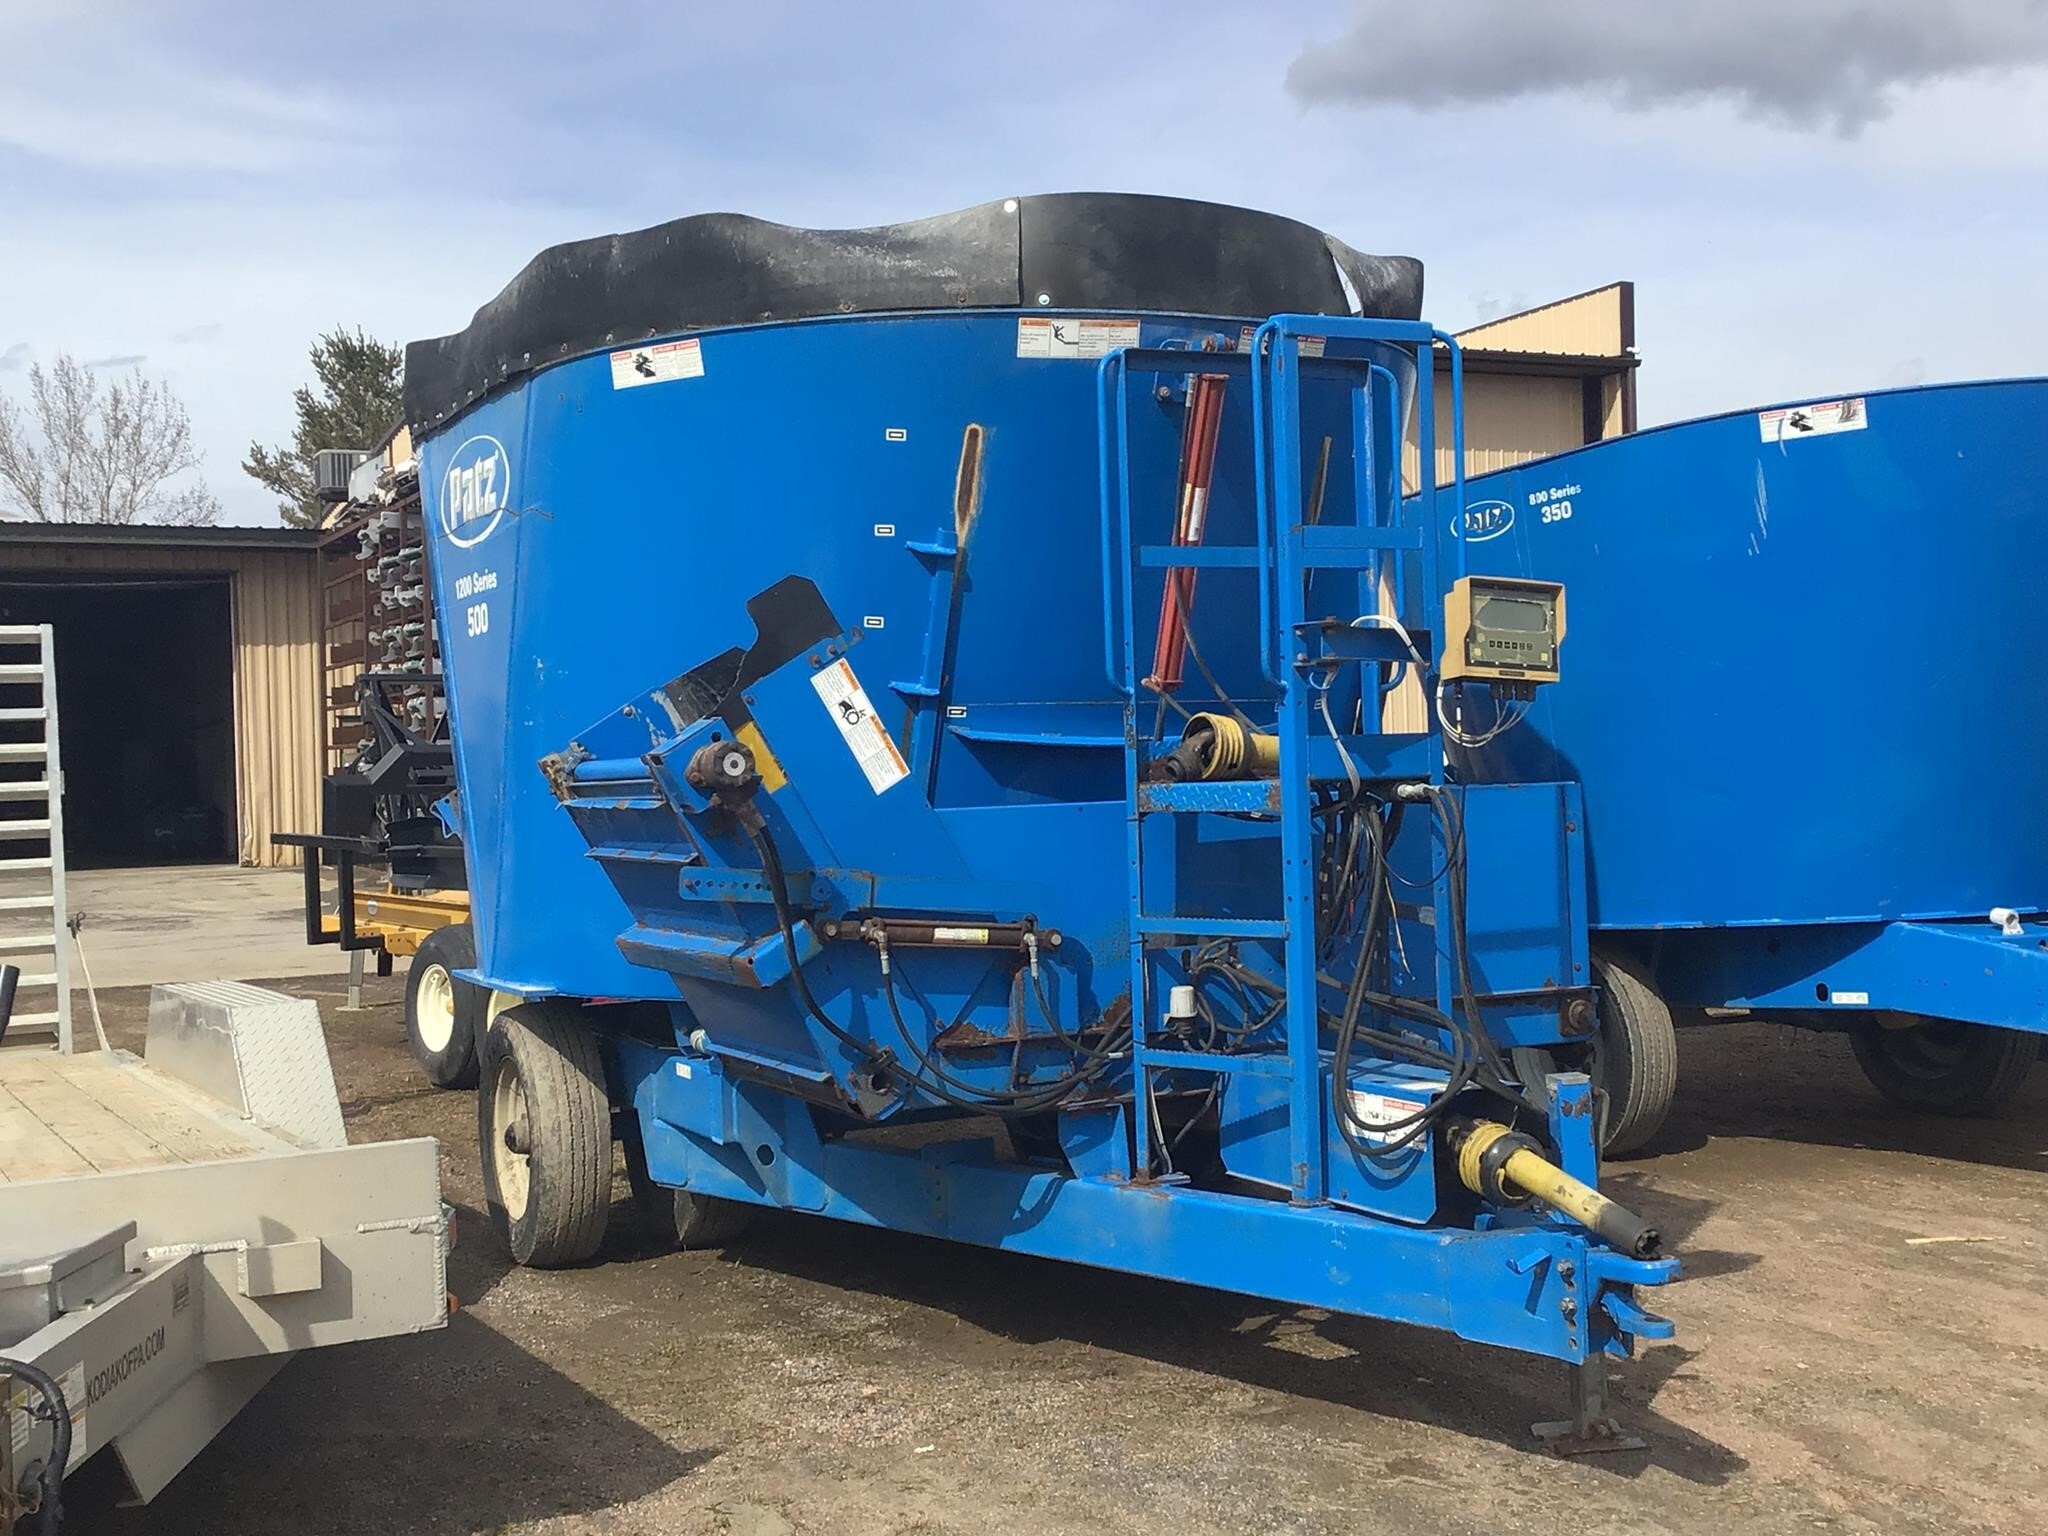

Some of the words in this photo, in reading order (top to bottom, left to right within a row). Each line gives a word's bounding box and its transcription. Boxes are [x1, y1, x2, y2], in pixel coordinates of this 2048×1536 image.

[450, 456, 497, 529] Patz
[1528, 490, 1548, 505] 800
[1550, 484, 1582, 500] Series
[1541, 501, 1572, 523] 350
[455, 575, 473, 600] 1200
[473, 569, 498, 594] Series
[467, 602, 489, 637] 500
[86, 1326, 165, 1408] KODIAKOFPA.COM
